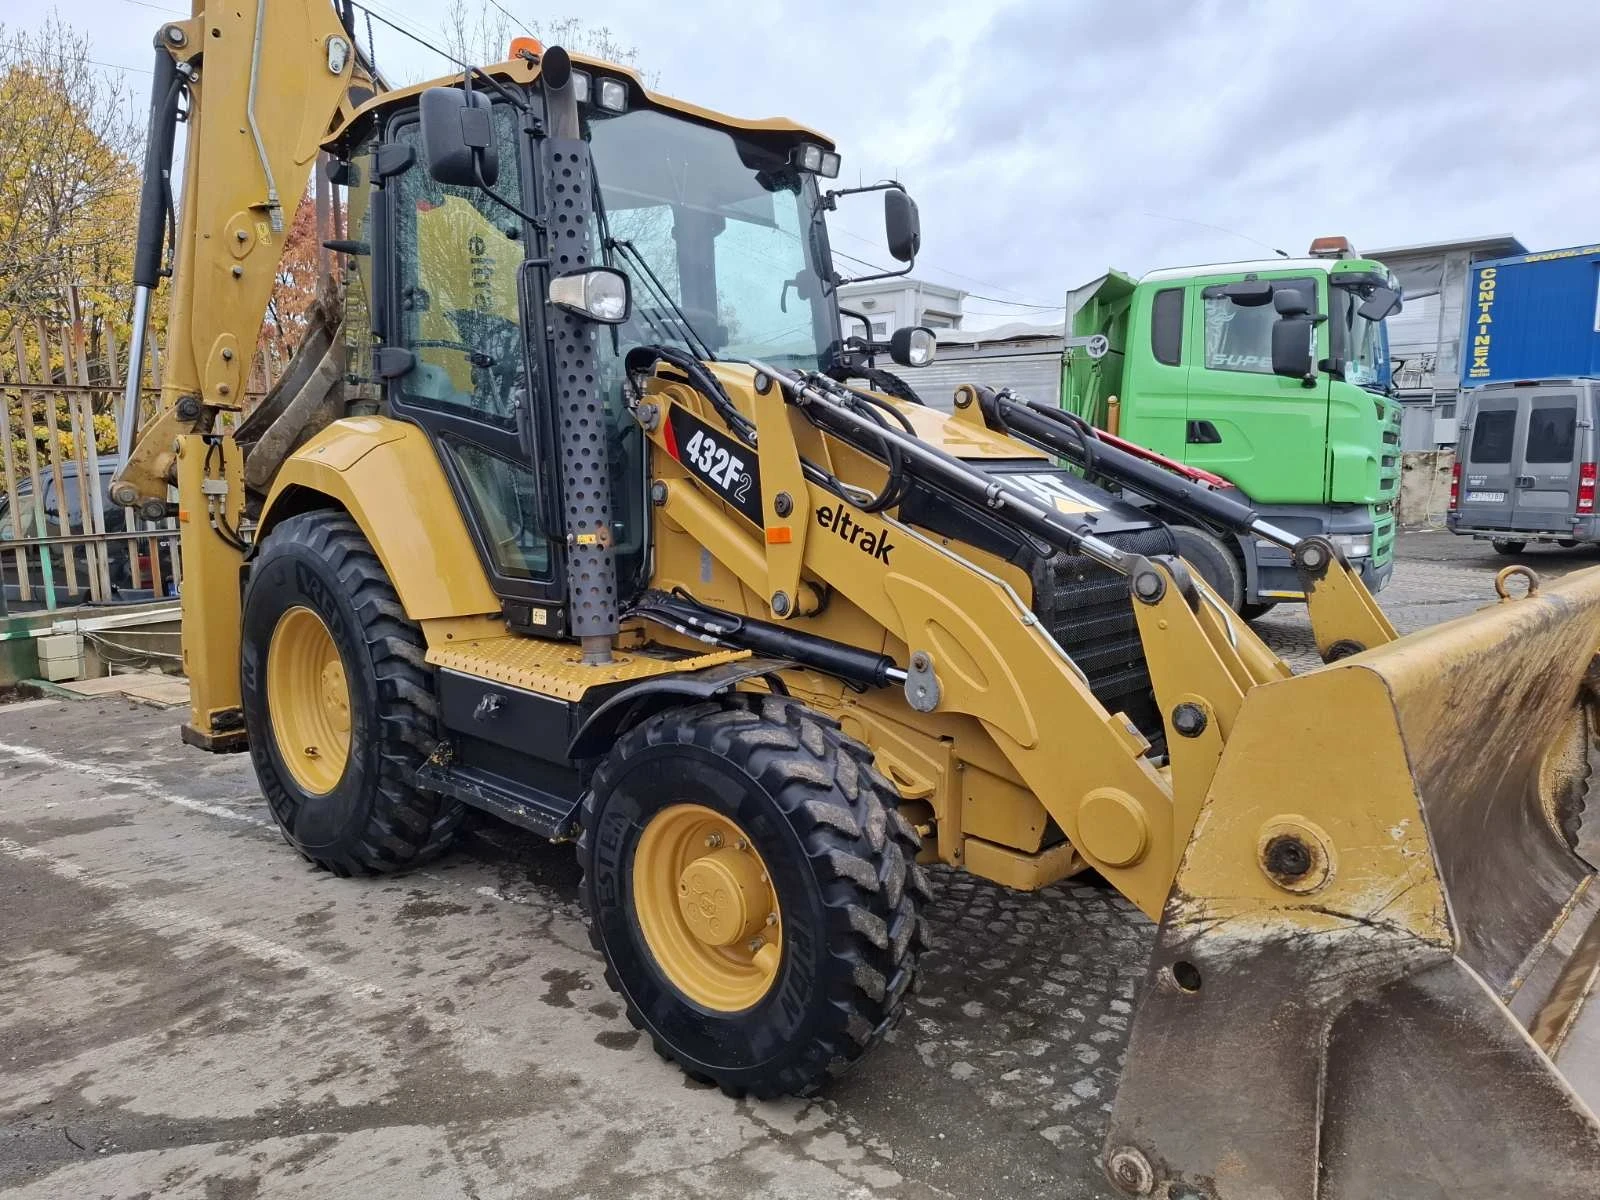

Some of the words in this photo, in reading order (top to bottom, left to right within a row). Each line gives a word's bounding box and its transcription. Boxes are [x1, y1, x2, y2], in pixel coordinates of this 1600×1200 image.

[1473, 268, 1497, 367] CONTAINEX
[1212, 353, 1272, 368] SUPE
[816, 504, 895, 566] eltrak
